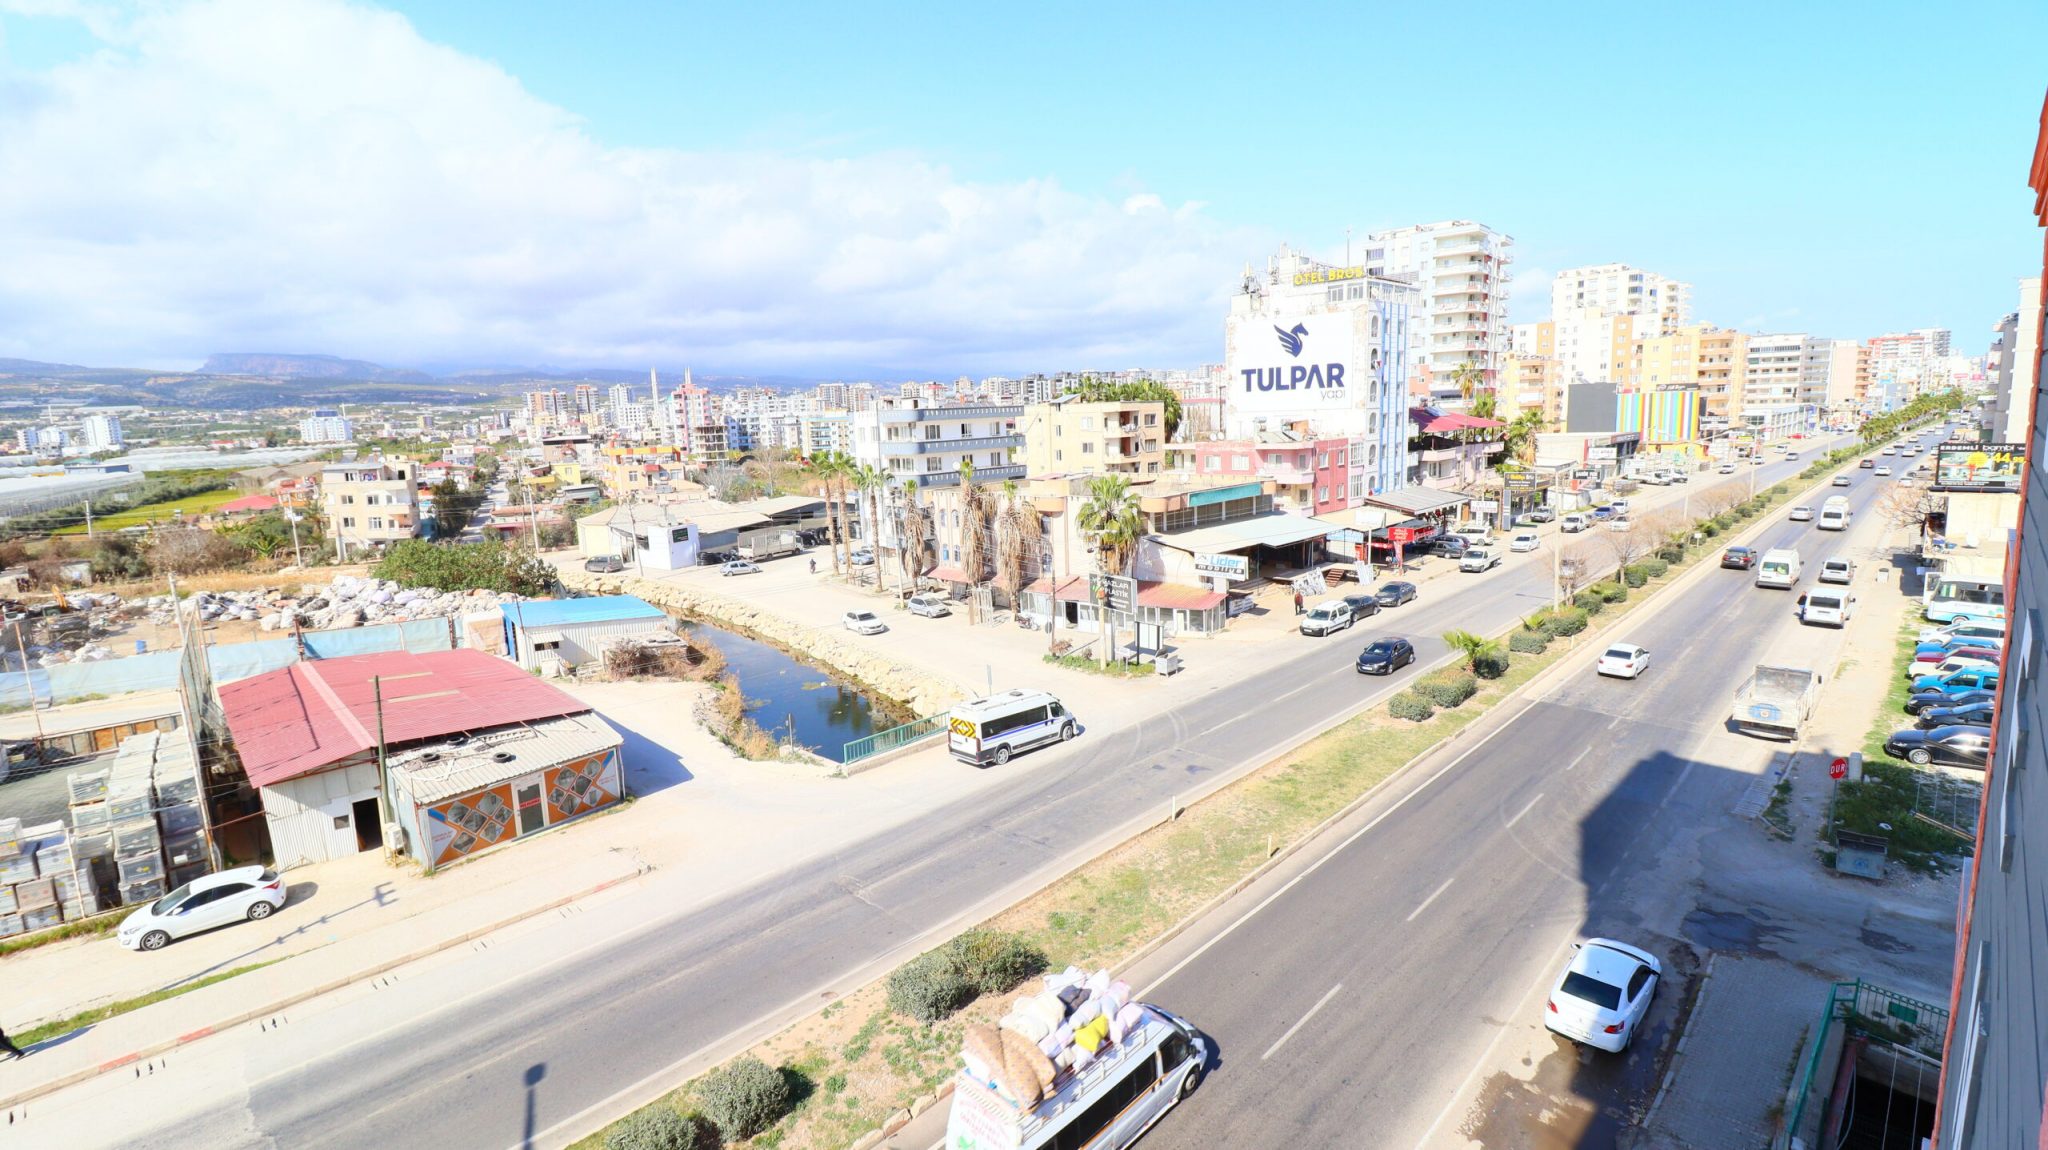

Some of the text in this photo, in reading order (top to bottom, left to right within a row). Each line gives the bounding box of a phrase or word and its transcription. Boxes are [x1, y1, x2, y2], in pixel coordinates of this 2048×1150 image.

[1294, 271, 1324, 286] OTEL
[1241, 363, 1345, 392] TULPAR
[1210, 554, 1242, 568] Lider
[1198, 564, 1242, 574] mobilya
[1830, 763, 1846, 774] DUR
